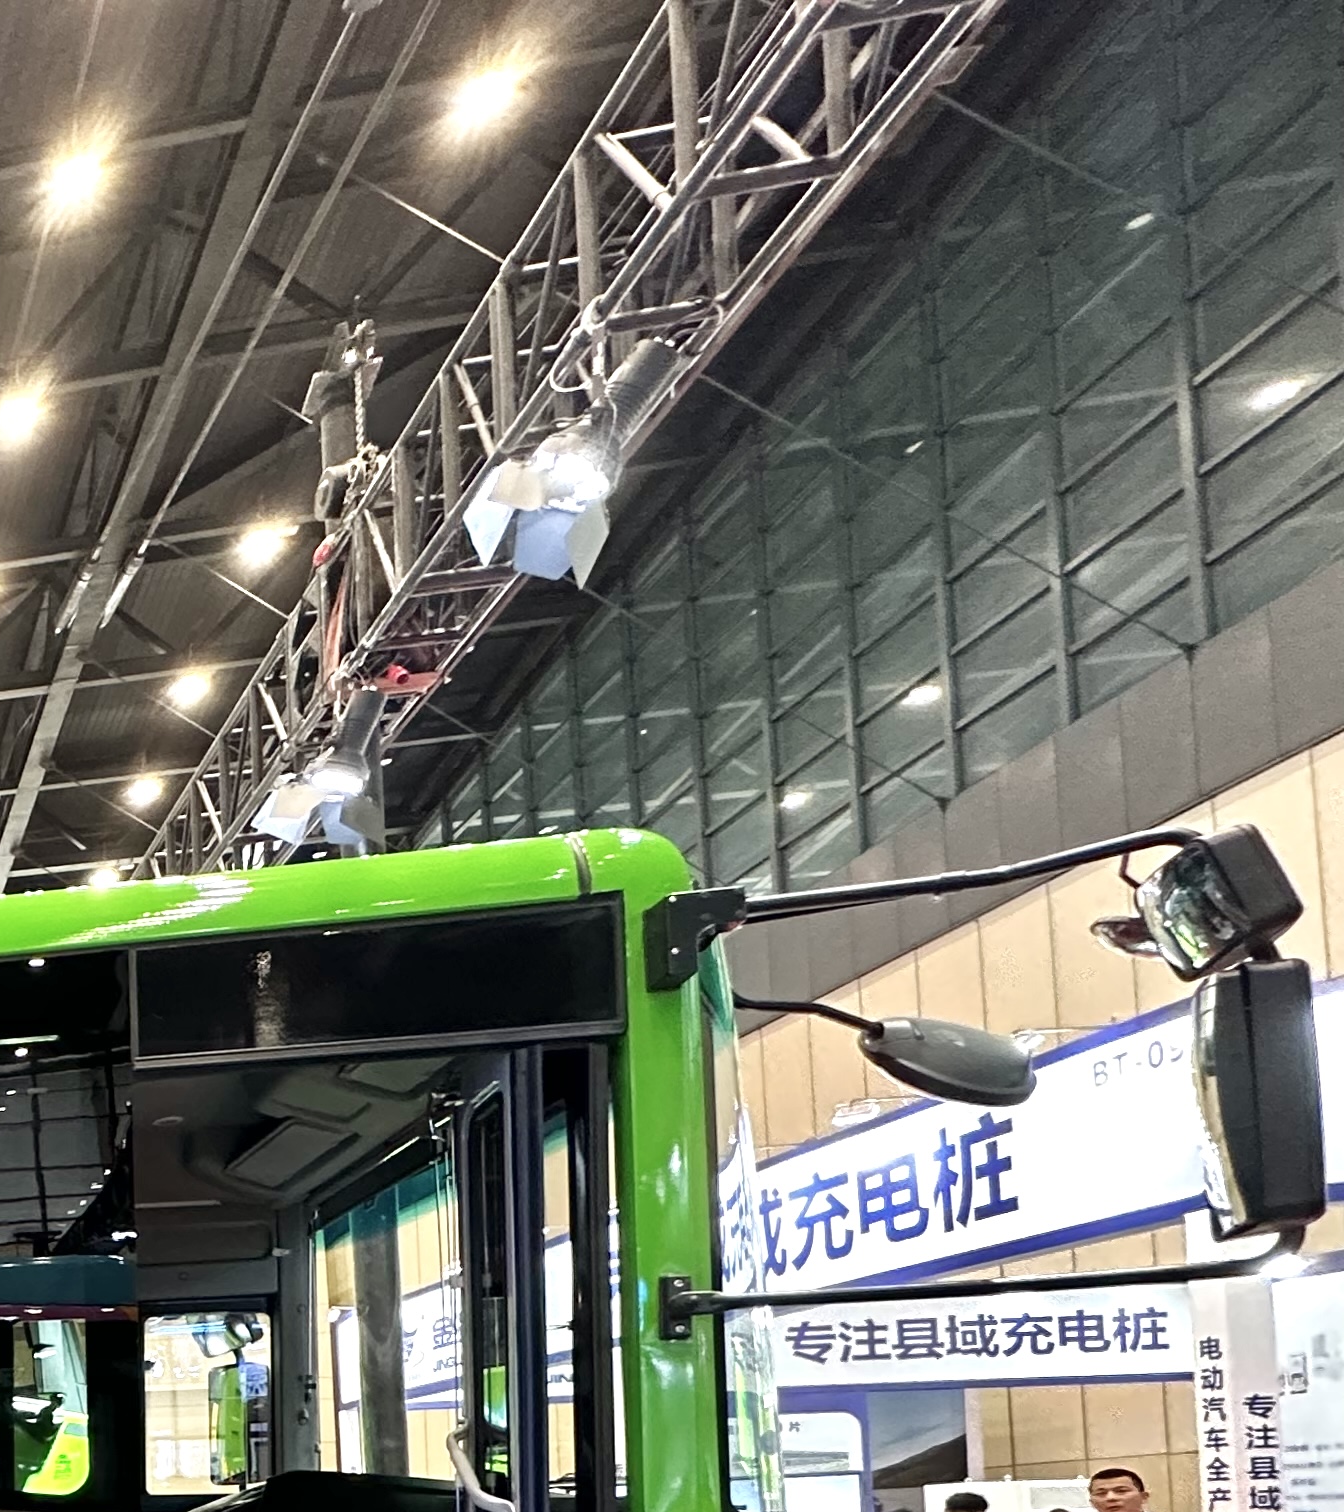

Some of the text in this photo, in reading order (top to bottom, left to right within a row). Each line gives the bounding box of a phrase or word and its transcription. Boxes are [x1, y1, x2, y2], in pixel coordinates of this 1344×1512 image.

[785, 1306, 1171, 1365] 专注县域充电桩
